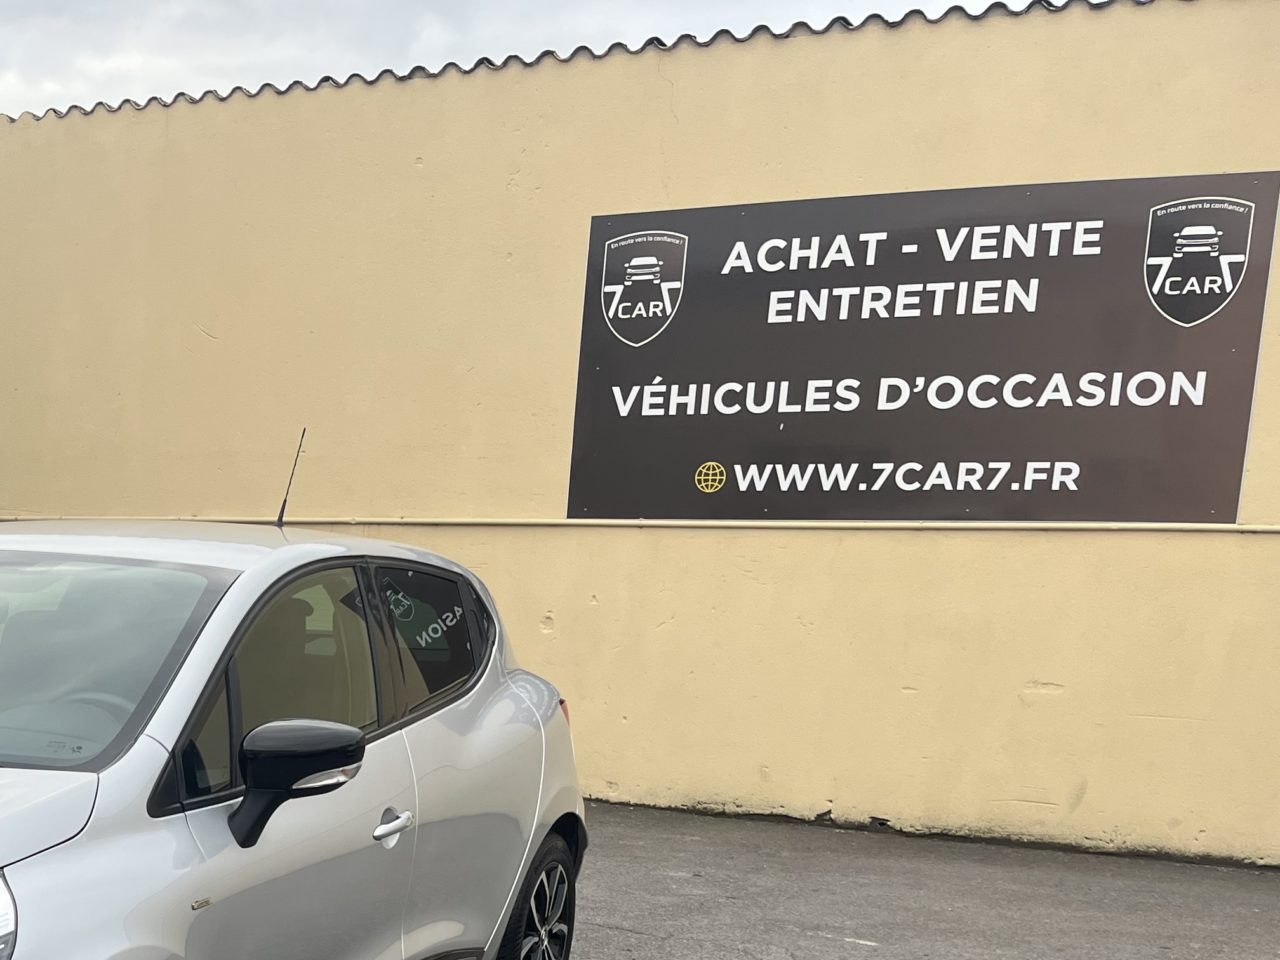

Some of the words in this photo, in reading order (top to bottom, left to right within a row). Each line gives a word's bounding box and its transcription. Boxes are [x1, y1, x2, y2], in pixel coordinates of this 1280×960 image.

[1187, 202, 1203, 210] vers
[1211, 202, 1244, 213] confiance
[720, 234, 888, 275] ACHAT
[935, 220, 1104, 262] VENTE
[767, 278, 1040, 324] ENTRETIEN
[611, 375, 861, 417] VÉHICULES
[733, 461, 1081, 492] WWW.7CAR7.FR
